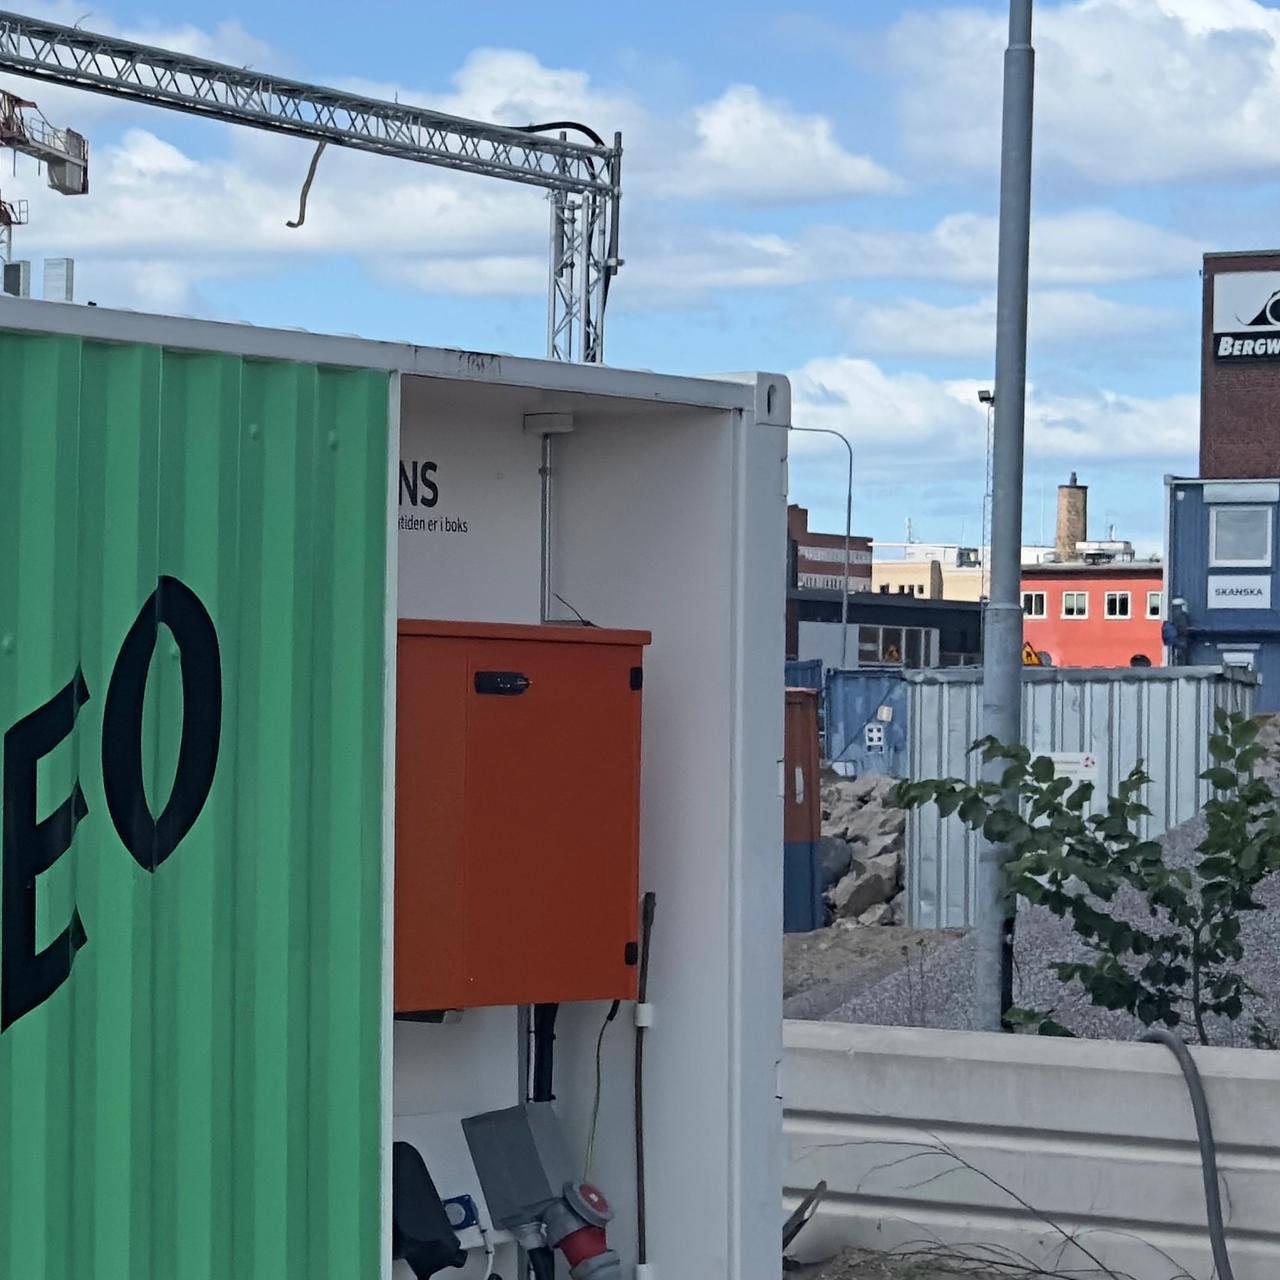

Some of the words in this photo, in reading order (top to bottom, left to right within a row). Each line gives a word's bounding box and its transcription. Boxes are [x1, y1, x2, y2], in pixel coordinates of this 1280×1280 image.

[399, 460, 439, 508] NS
[398, 515, 425, 531] tiden
[428, 519, 438, 532] er
[445, 517, 468, 532] boks
[1215, 588, 1263, 597] SKANSKA
